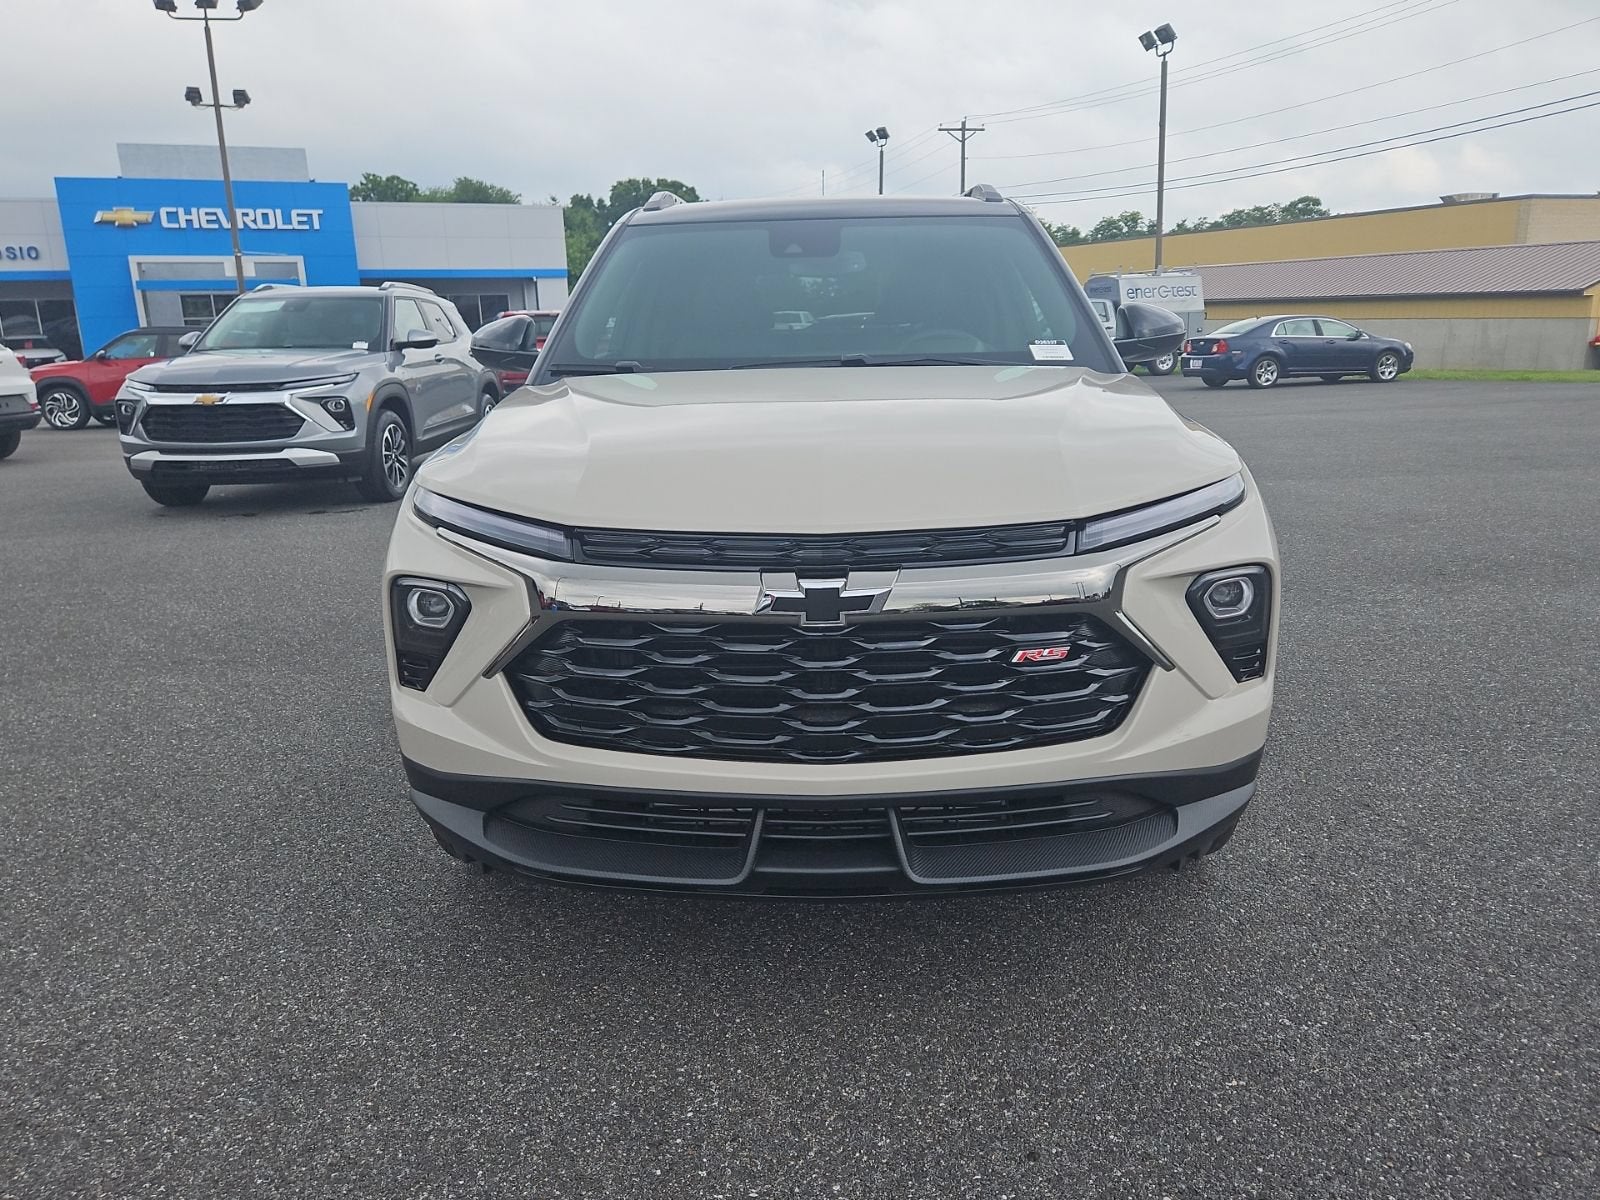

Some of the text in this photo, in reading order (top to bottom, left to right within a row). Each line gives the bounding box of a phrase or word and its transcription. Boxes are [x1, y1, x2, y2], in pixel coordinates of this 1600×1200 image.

[159, 206, 323, 230] CHEVROLET
[0, 246, 39, 260] SIO
[1011, 646, 1071, 663] RS
